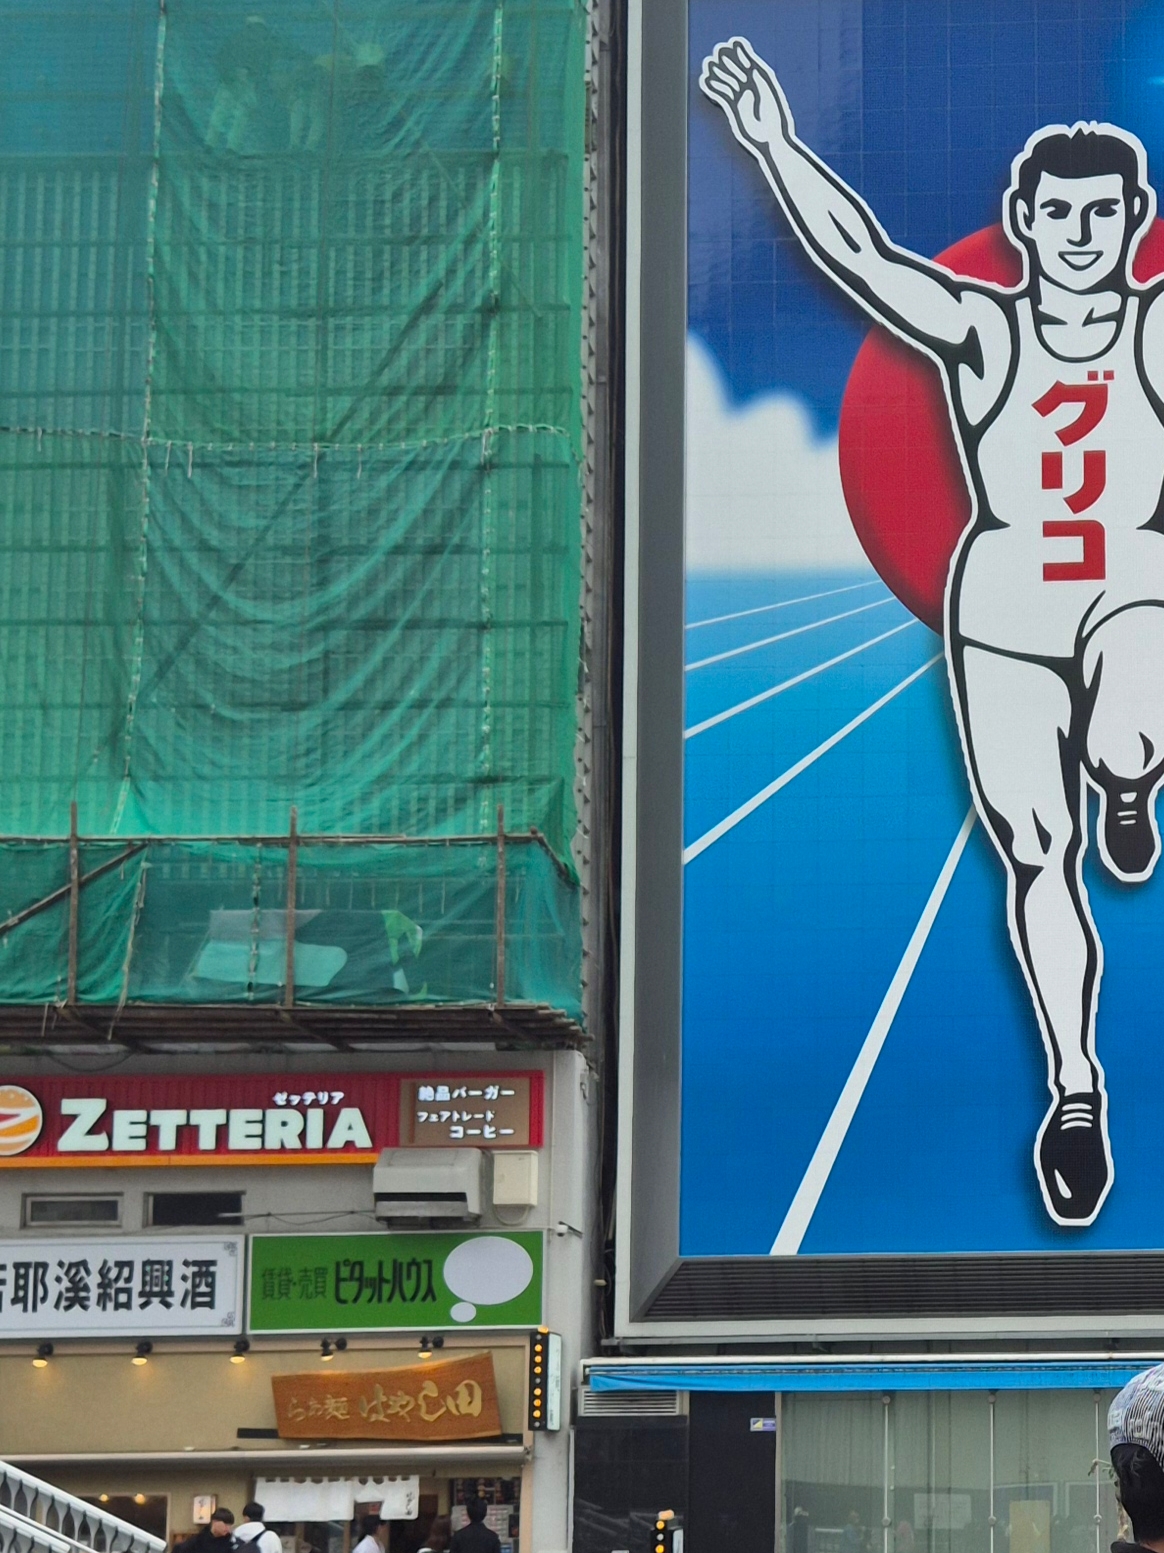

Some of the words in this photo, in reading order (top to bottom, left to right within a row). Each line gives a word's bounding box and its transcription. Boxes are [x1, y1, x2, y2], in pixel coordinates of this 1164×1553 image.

[1031, 370, 1115, 582] グリコ
[272, 1091, 345, 1106] ゼッテリア
[417, 1084, 516, 1102] 絶品バーガー
[57, 1098, 373, 1152] ZETTERIA
[416, 1110, 496, 1123] フェアトレード
[449, 1124, 515, 1139] コーヒー
[0, 1258, 218, 1313] 耶溪紹興酒
[334, 1258, 437, 1305] ピタットハウス
